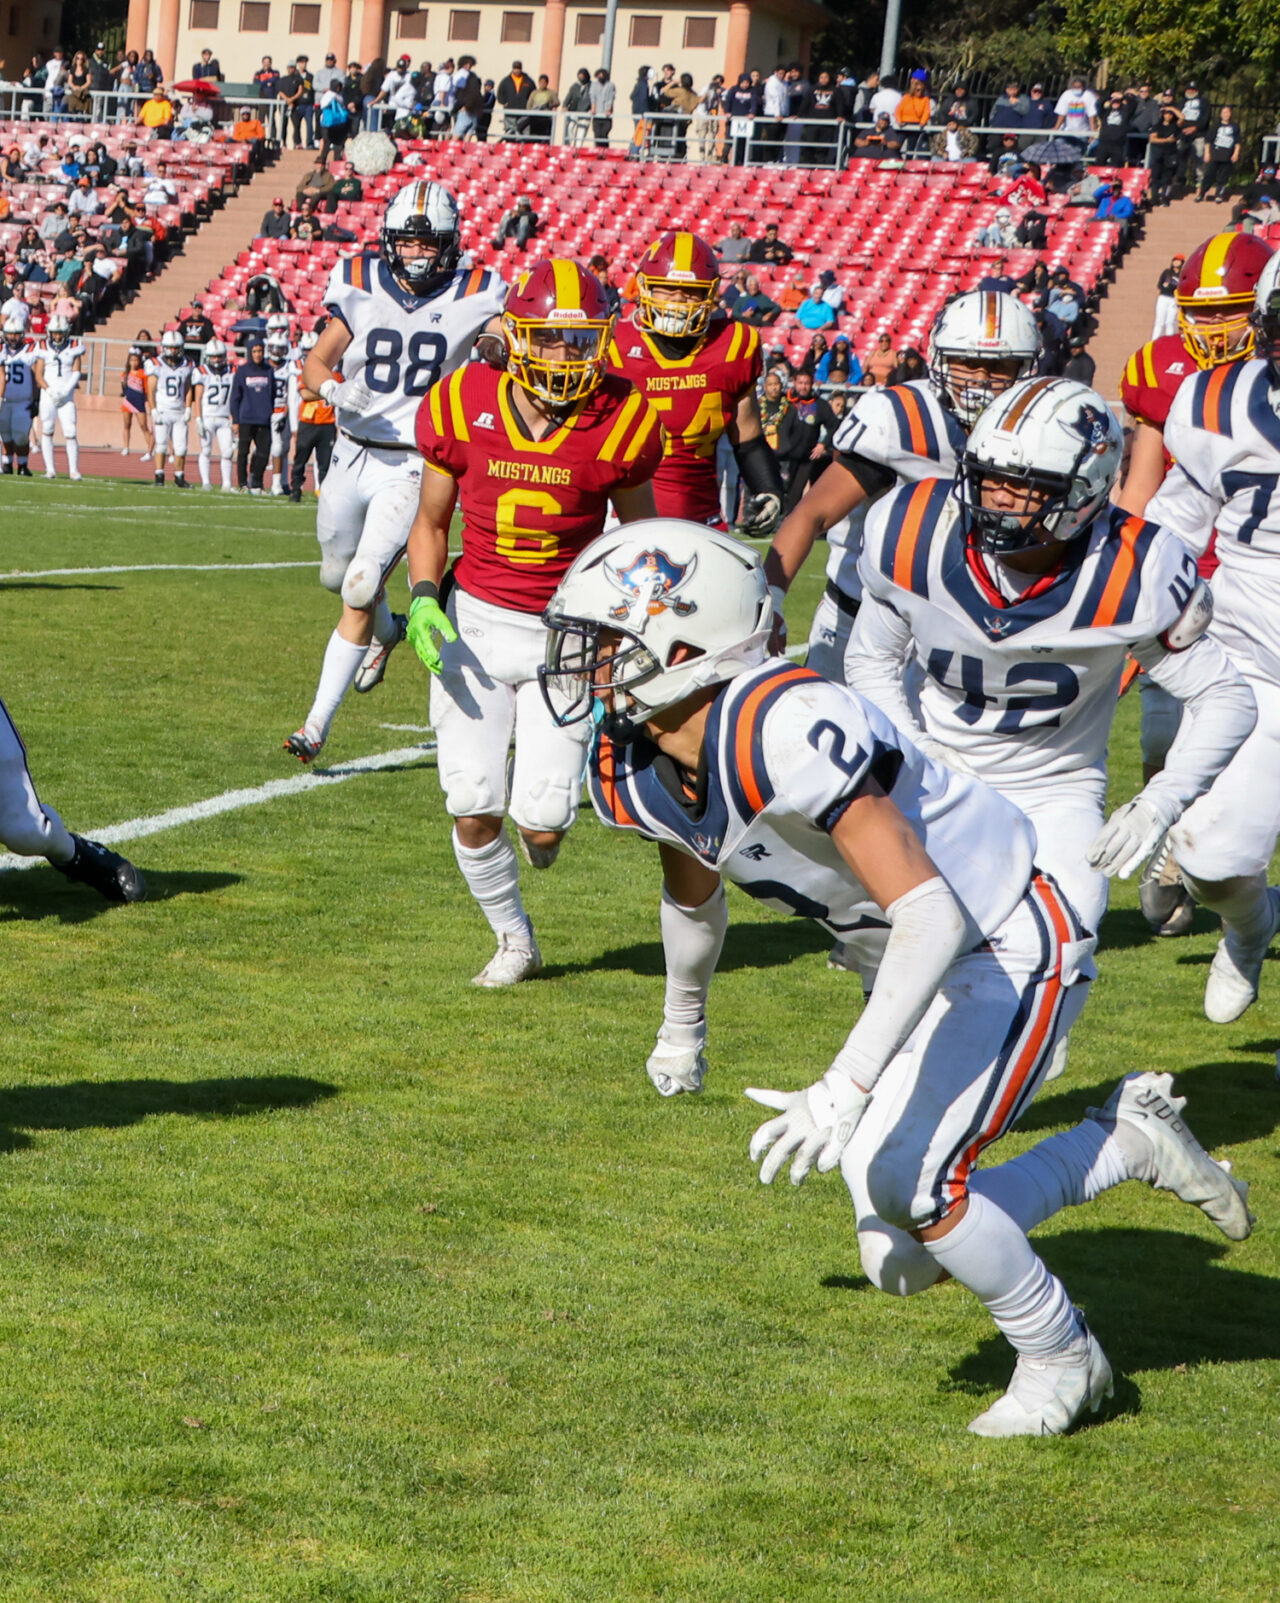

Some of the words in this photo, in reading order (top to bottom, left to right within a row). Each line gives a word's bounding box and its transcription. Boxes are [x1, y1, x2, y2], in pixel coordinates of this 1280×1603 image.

[737, 122, 748, 133] M
[553, 311, 583, 319] Riddell
[365, 327, 448, 397] 88
[207, 383, 231, 405] 27
[646, 373, 707, 392] MUSTANGS
[836, 413, 868, 451] 71
[487, 459, 572, 486] MUSTANGS
[495, 488, 562, 565] 6
[926, 647, 1080, 735] 42
[807, 718, 869, 779] 2
